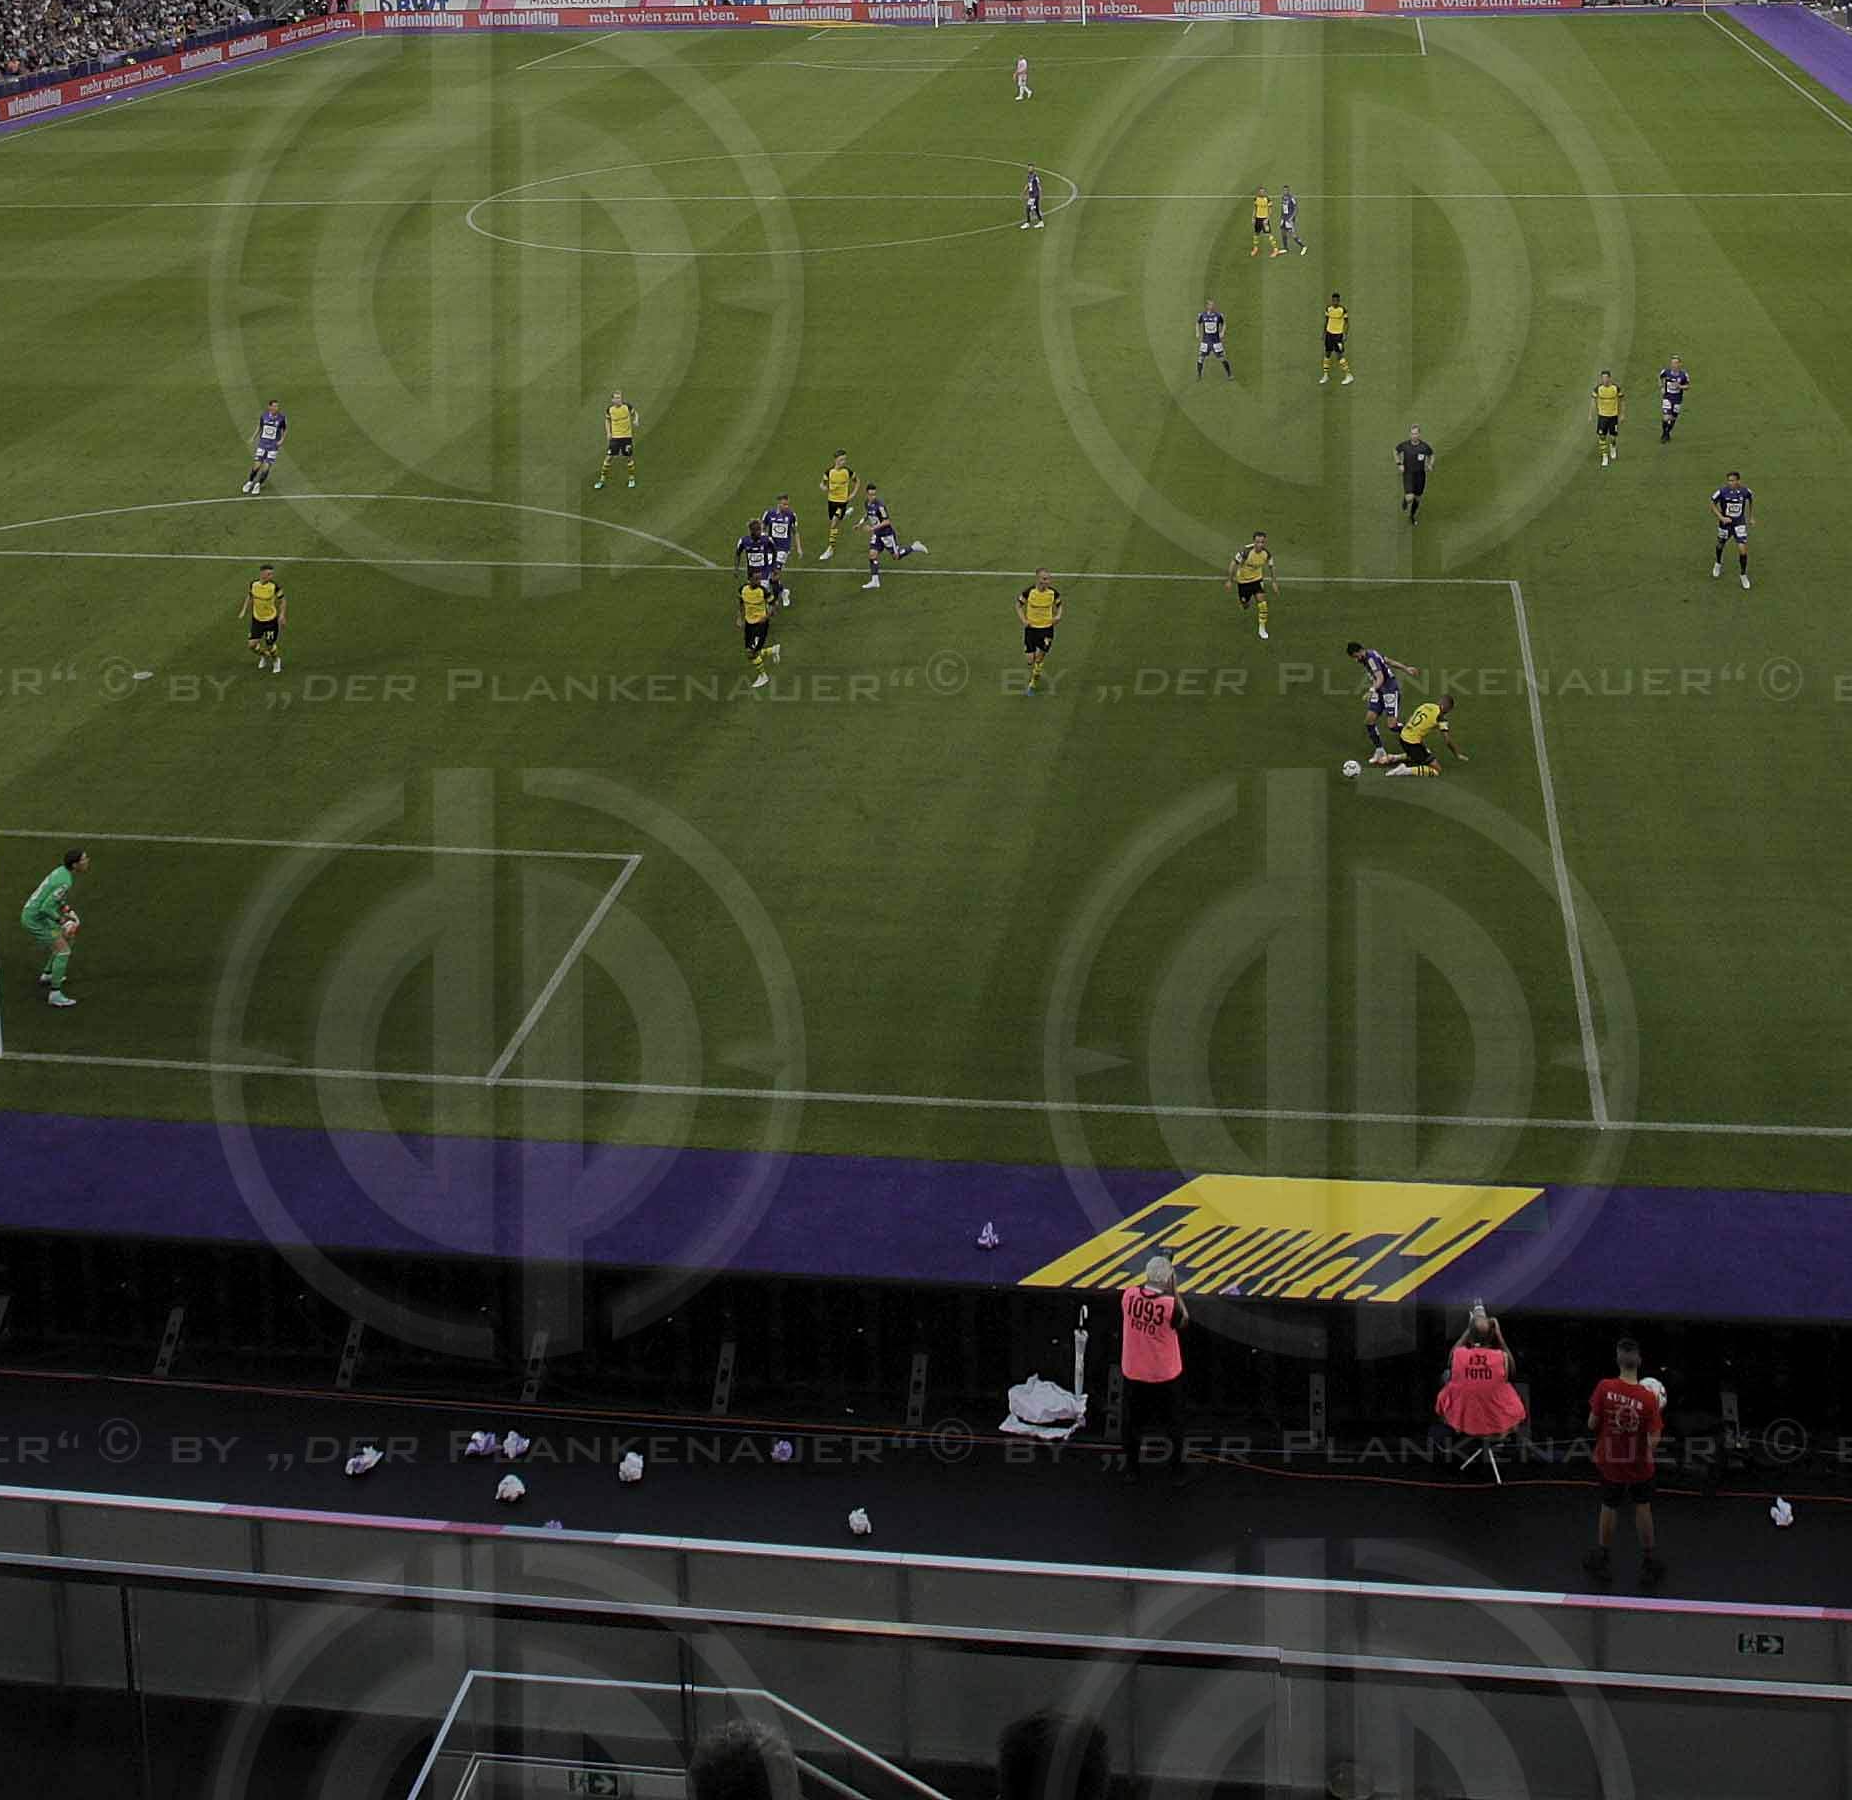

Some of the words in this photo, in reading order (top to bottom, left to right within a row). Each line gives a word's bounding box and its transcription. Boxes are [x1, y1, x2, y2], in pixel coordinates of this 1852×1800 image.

[589, 11, 625, 23] mehr
[628, 11, 661, 23] wien
[664, 13, 694, 22] zum
[697, 9, 739, 21] leben.
[984, 2, 1022, 16] mehr
[1025, 2, 1061, 16] wien
[1064, 5, 1095, 15] zum
[1099, 1, 1143, 14] leben.
[1127, 1296, 1165, 1326] 1093
[1131, 1318, 1156, 1336] FOTO
